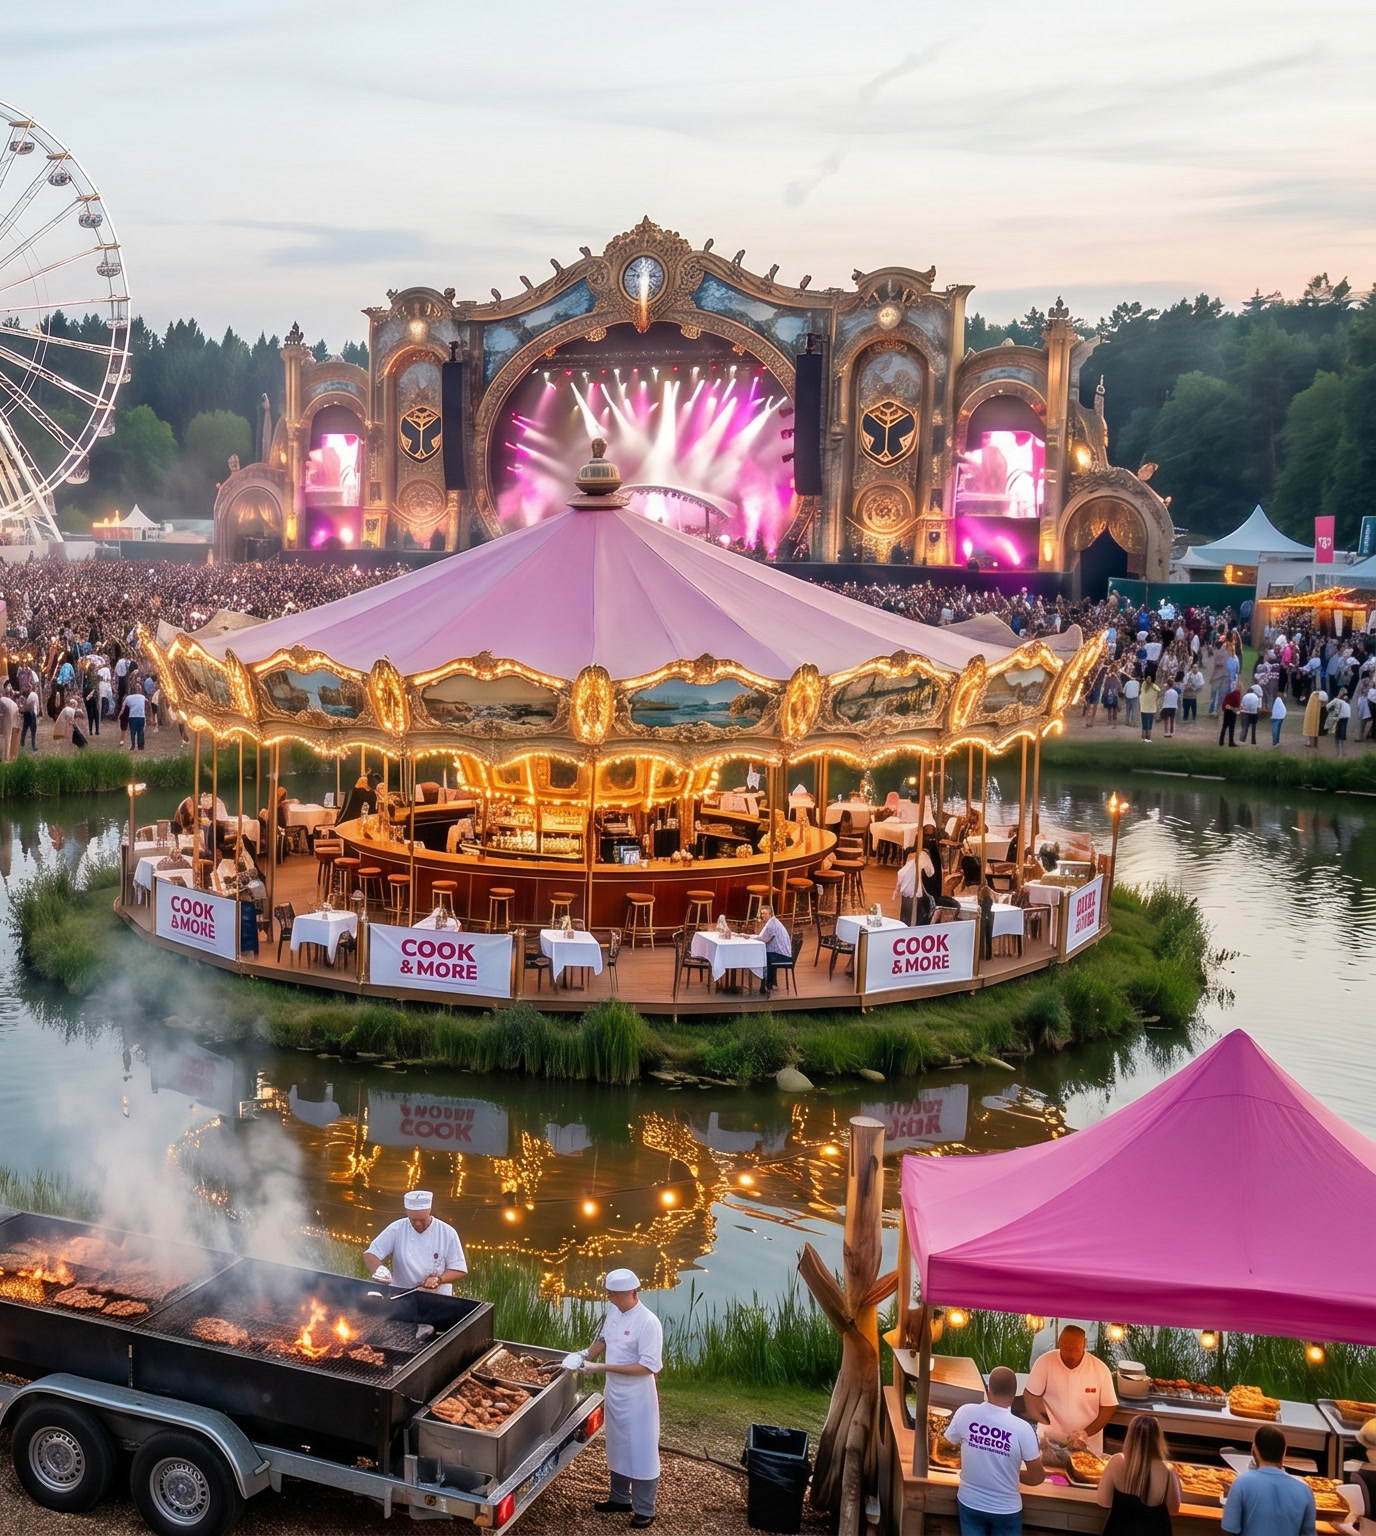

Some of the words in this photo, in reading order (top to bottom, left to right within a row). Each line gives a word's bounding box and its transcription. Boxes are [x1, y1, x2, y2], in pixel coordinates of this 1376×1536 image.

[170, 895, 215, 923] COOK
[401, 938, 476, 963] COOK
[892, 933, 950, 957] COOK
[400, 959, 414, 974] &
[416, 960, 478, 981] MORE
[891, 959, 903, 975] &
[905, 954, 950, 973] MORE
[968, 1422, 1013, 1444] COOK
